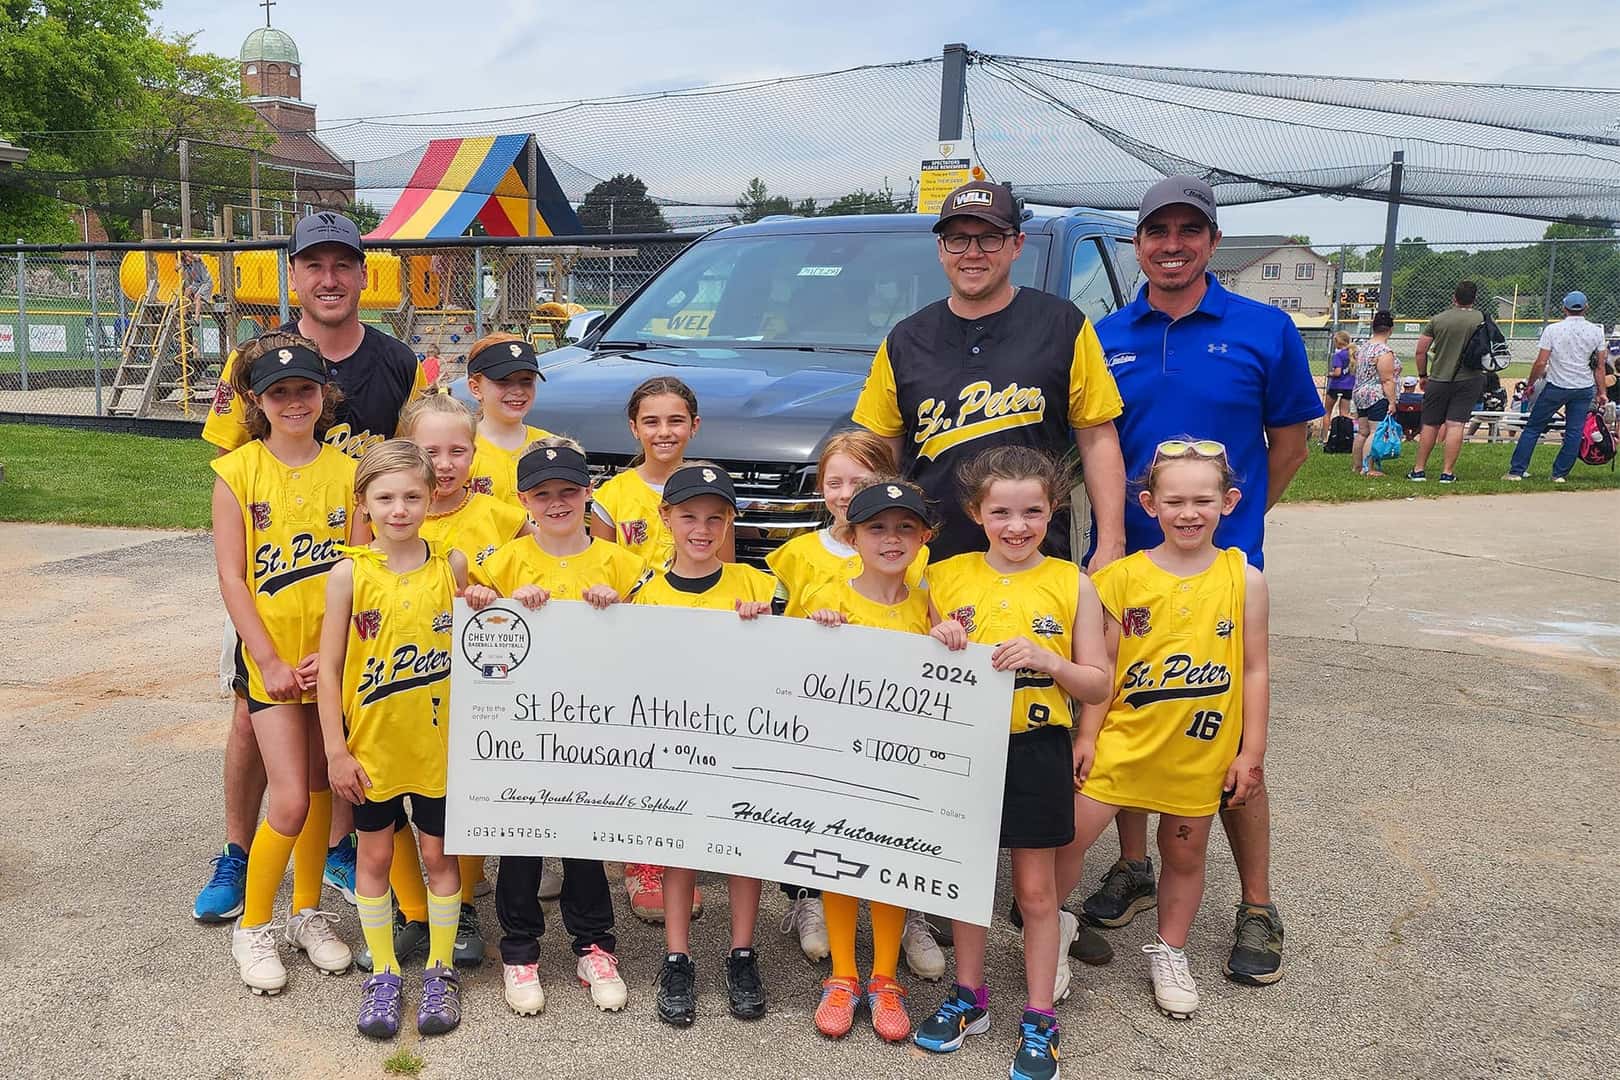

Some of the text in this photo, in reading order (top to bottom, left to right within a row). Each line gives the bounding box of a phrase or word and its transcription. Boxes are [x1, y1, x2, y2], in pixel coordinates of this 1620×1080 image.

[1340, 293, 1348, 304] 2
[1357, 293, 1366, 304] 6
[914, 380, 1045, 443] St. Peter
[254, 543, 287, 579] St.
[468, 633, 525, 643] CHEVY YOUTH
[391, 644, 451, 681] Peter
[921, 662, 978, 686] 2024
[1123, 653, 1228, 689] St. Peter
[775, 687, 793, 696] Date
[803, 673, 953, 721] 06/15/2024
[472, 705, 485, 713] Pay
[551, 691, 616, 724] Peter
[630, 694, 737, 736] Athletic
[748, 706, 809, 743] Club
[1185, 710, 1224, 741] 16
[477, 730, 525, 760] One
[535, 733, 656, 769] Thousand
[852, 739, 863, 754] $
[500, 788, 536, 805] Chevy
[538, 789, 573, 805] Youth
[575, 791, 625, 806] Baseball
[640, 795, 689, 812] Softball
[940, 807, 966, 820] Dollars
[732, 801, 943, 857] Holiday Automotive
[592, 831, 685, 850] 1234567890
[707, 842, 742, 857] 2024
[879, 868, 960, 900] CARES
